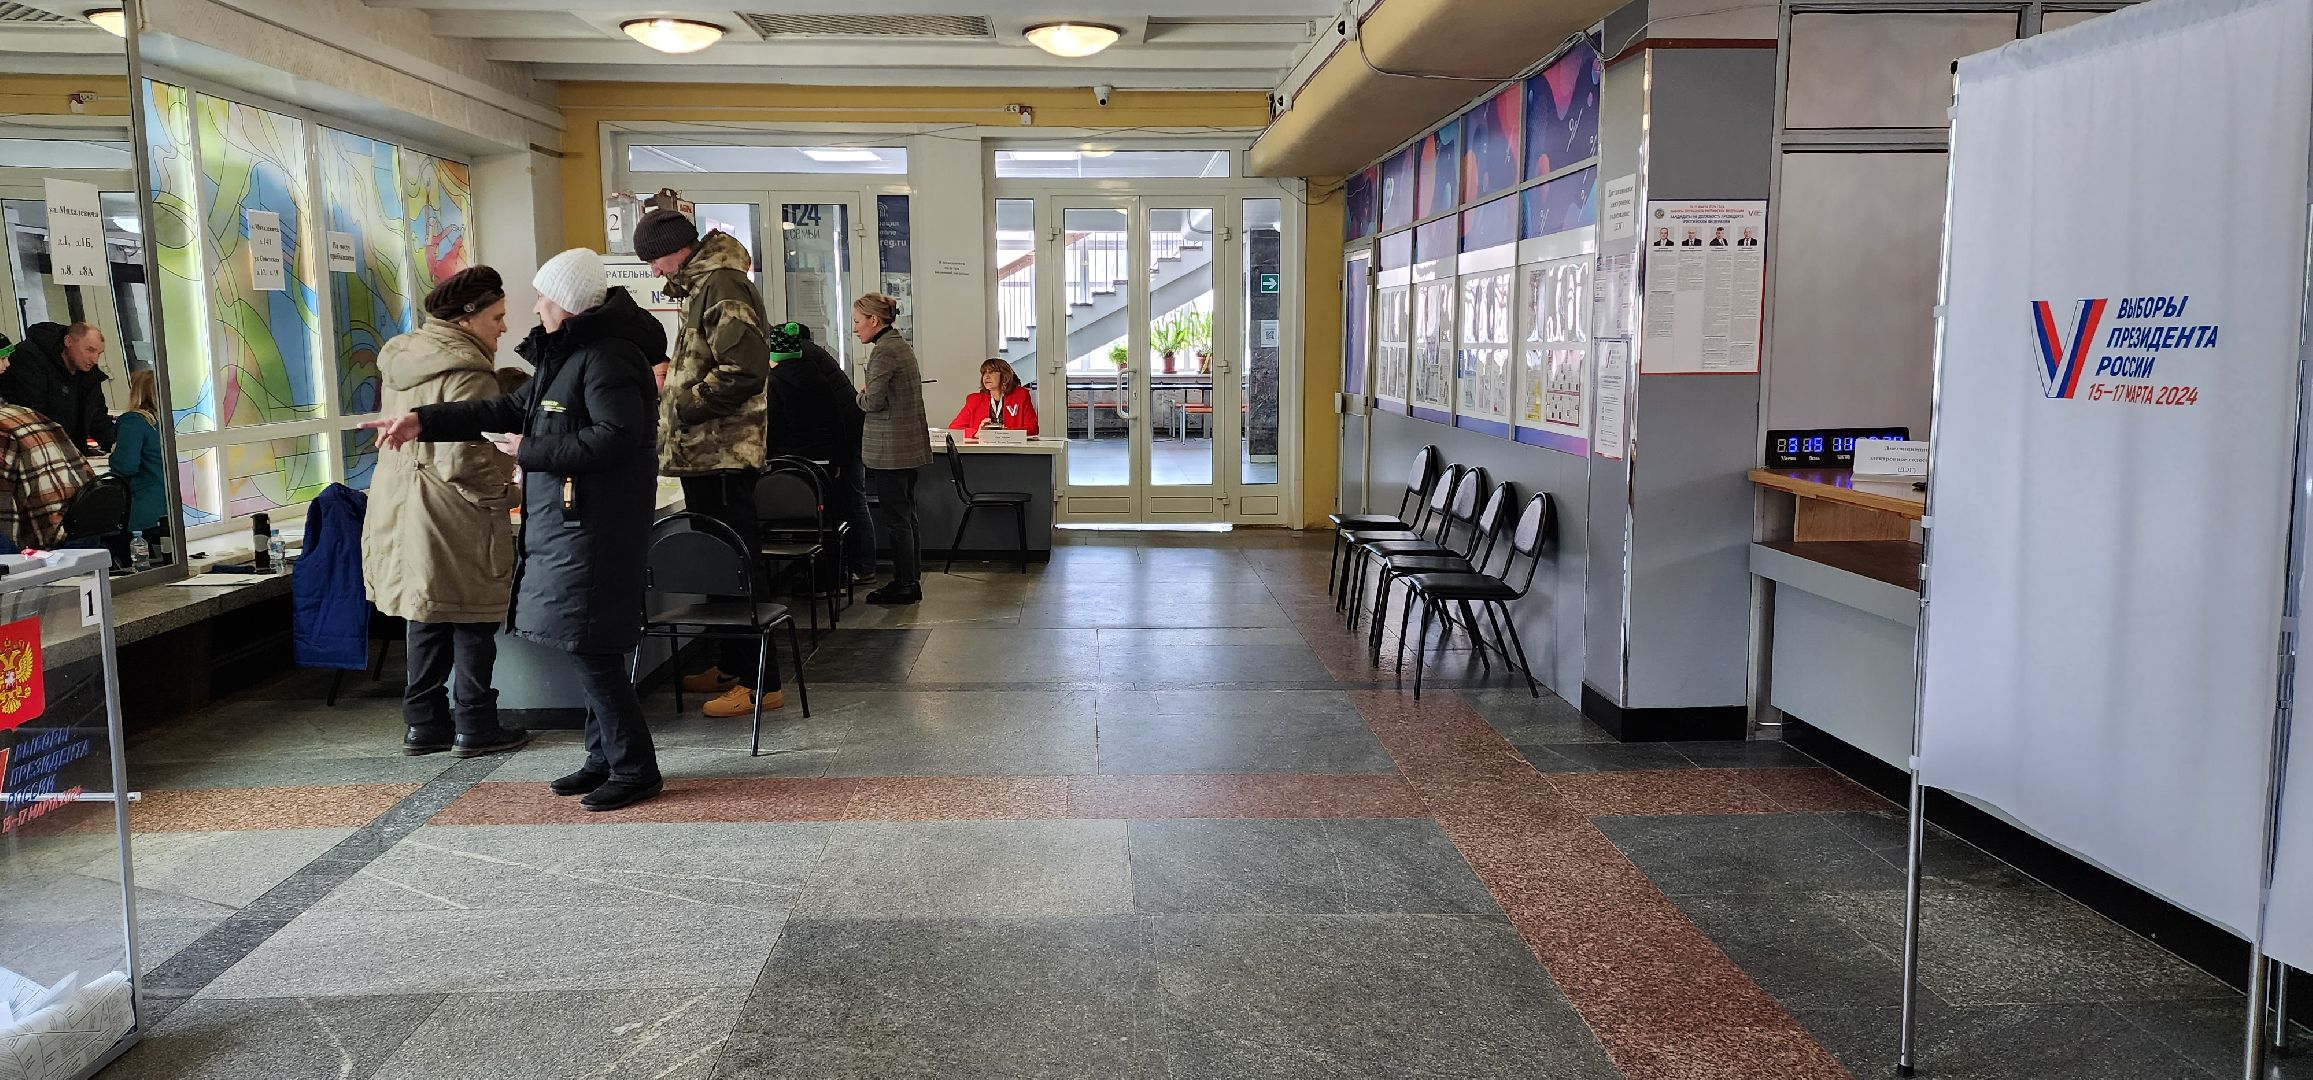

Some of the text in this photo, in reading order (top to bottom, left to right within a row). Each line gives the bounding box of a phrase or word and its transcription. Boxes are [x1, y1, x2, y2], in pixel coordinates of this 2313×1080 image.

[609, 213, 620, 231] 2
[605, 270, 654, 280] РАТЕЛЬНЫ
[2116, 295, 2189, 319] ВЫБОРЫ
[2106, 325, 2219, 352] ПРЕЗИДЕНТА
[2095, 356, 2156, 379] РОССИИ
[2125, 385, 2153, 405] МАРТА
[2155, 386, 2198, 406] 2024
[85, 589, 95, 618] 1
[13, 725, 71, 762] ВЫБОРЫ
[9, 738, 90, 786] ПРЕЗИДЕНТА
[5, 773, 57, 812] РОССИИ
